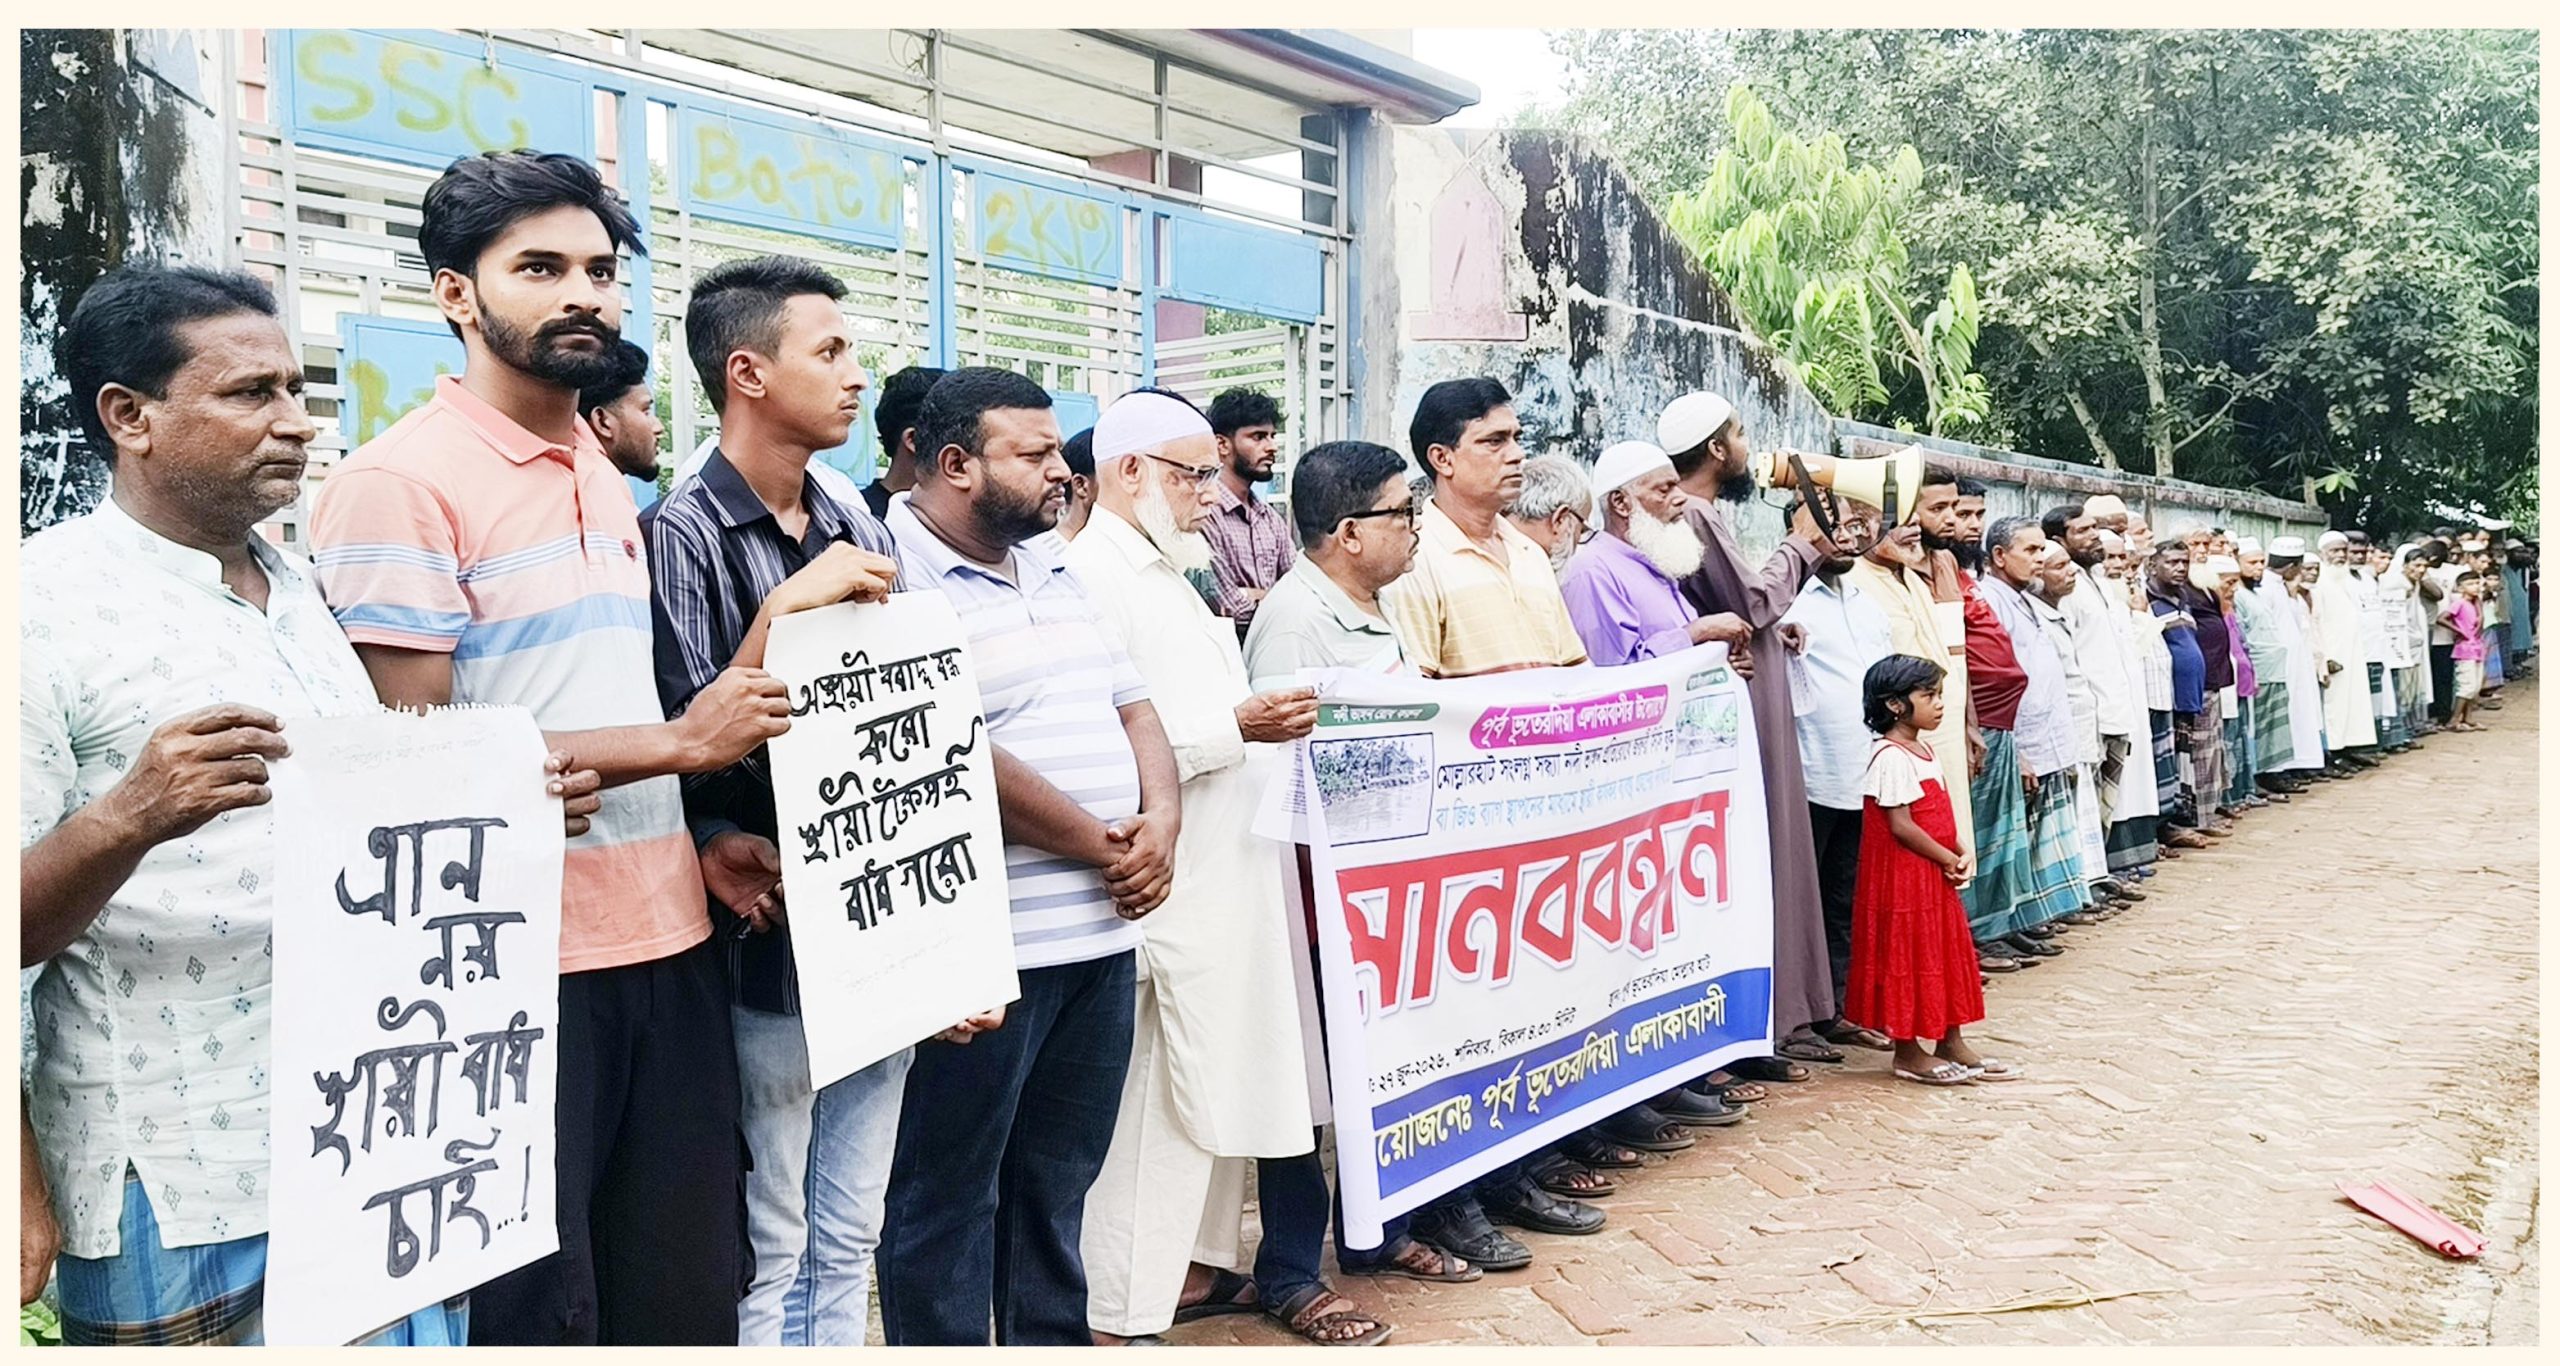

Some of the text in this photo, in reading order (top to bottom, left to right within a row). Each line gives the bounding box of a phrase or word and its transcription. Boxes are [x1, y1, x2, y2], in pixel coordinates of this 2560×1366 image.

[298, 31, 529, 154] SSC
[855, 701, 936, 765] করো
[1481, 708, 1510, 748] পূর্ব
[1577, 693, 1634, 730] এলাকাবাসীর
[1437, 754, 1496, 791] মোল্লারহাট
[1499, 755, 1532, 784] সংলগ্ন
[1436, 808, 1450, 833] বা
[1336, 789, 1731, 1014] মানববন্ধন
[420, 912, 526, 990] নয়
[1375, 982, 1727, 1168] য়োজনেঃ পূর্ব ভূতেরদিয়া এলাকাবাসী
